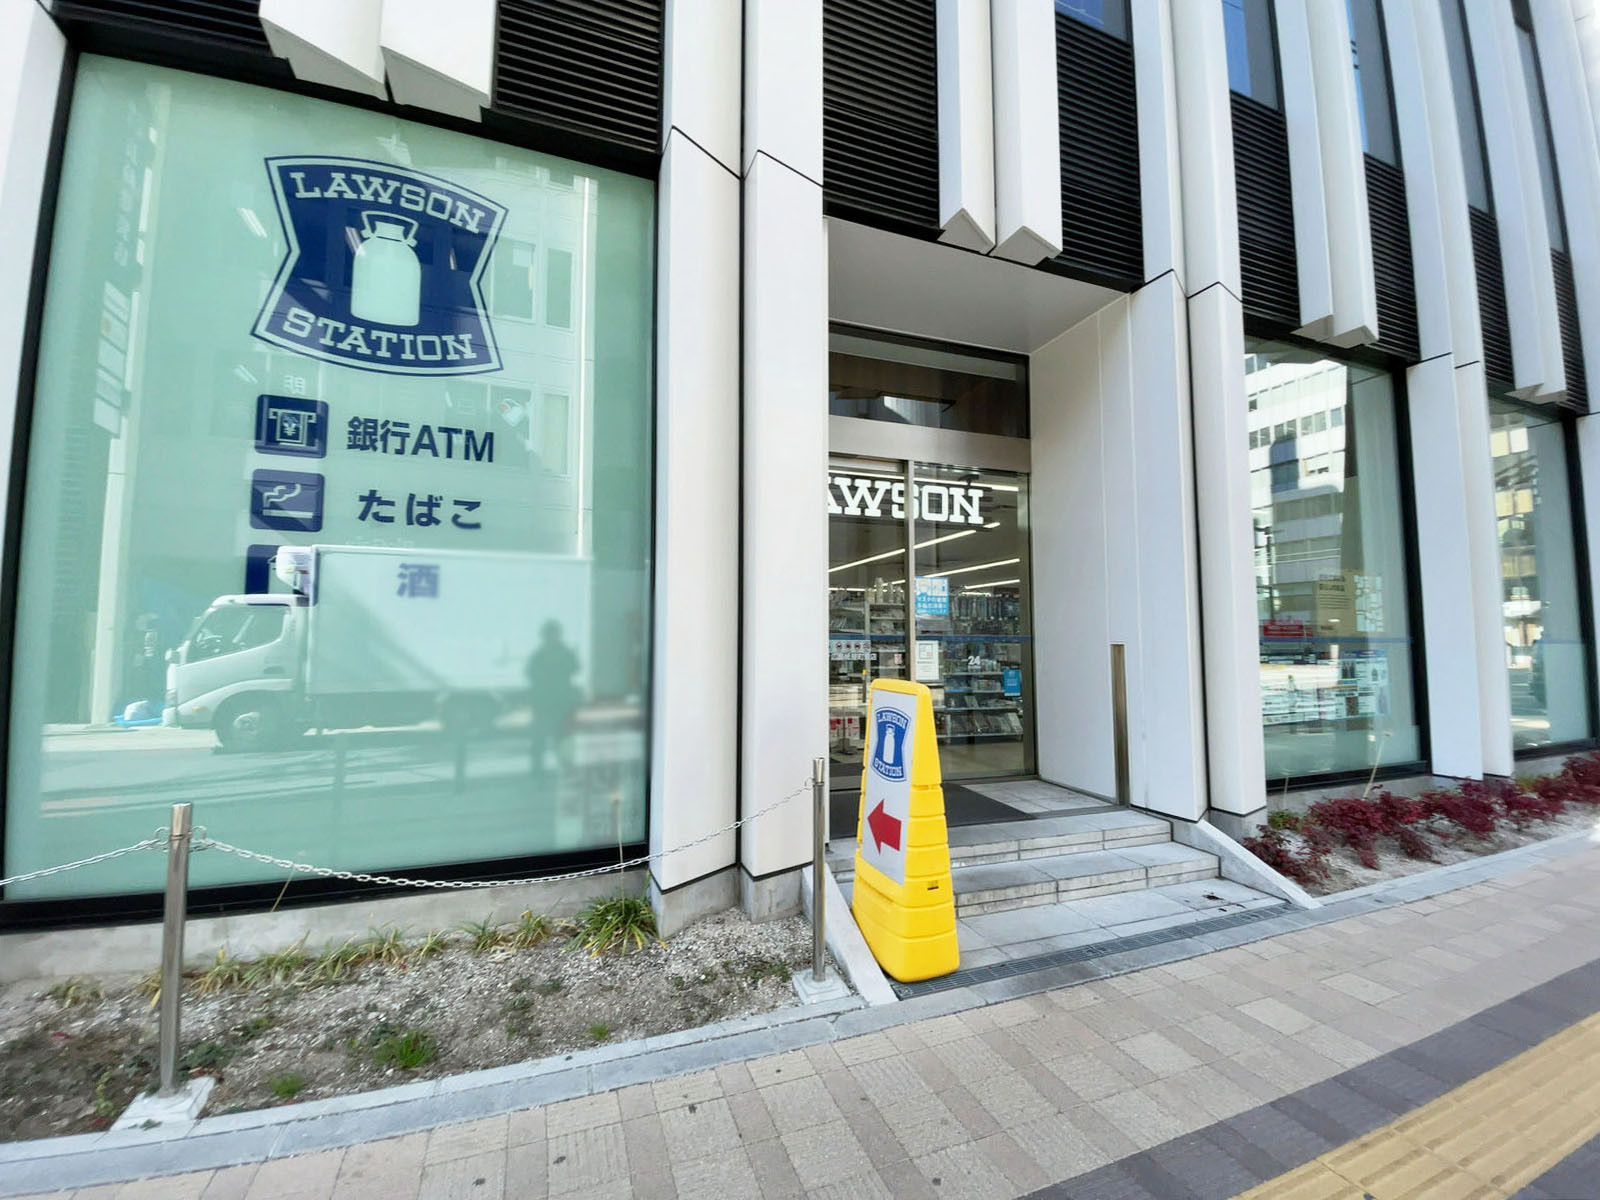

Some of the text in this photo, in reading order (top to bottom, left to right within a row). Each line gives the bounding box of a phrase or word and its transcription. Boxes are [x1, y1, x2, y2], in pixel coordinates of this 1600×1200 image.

[290, 171, 486, 234] LAWSON
[283, 308, 478, 362] STATION
[346, 415, 495, 463] 銀行ATM
[357, 488, 483, 530] たばこ
[396, 562, 440, 598] 酒
